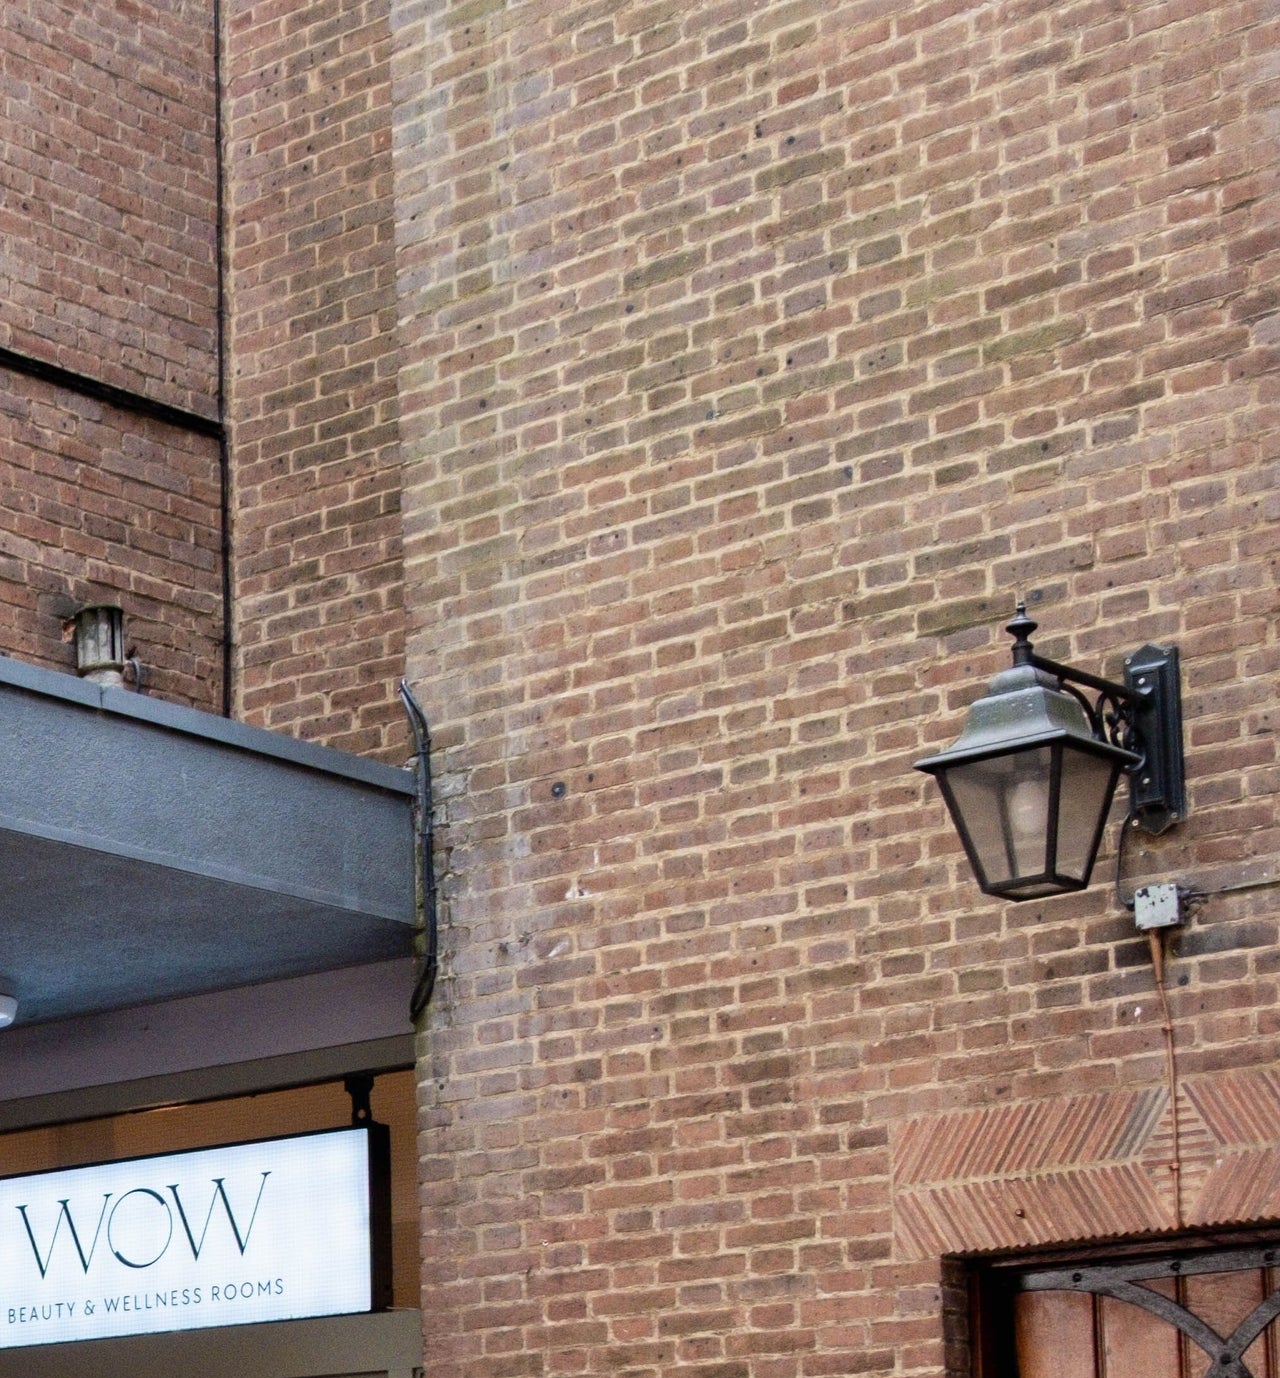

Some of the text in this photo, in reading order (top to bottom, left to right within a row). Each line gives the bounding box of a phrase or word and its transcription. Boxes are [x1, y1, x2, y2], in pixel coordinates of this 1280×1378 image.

[15, 1171, 272, 1280] WOW
[8, 1278, 285, 1324] BEAUTY & WELLNESS ROOMS
